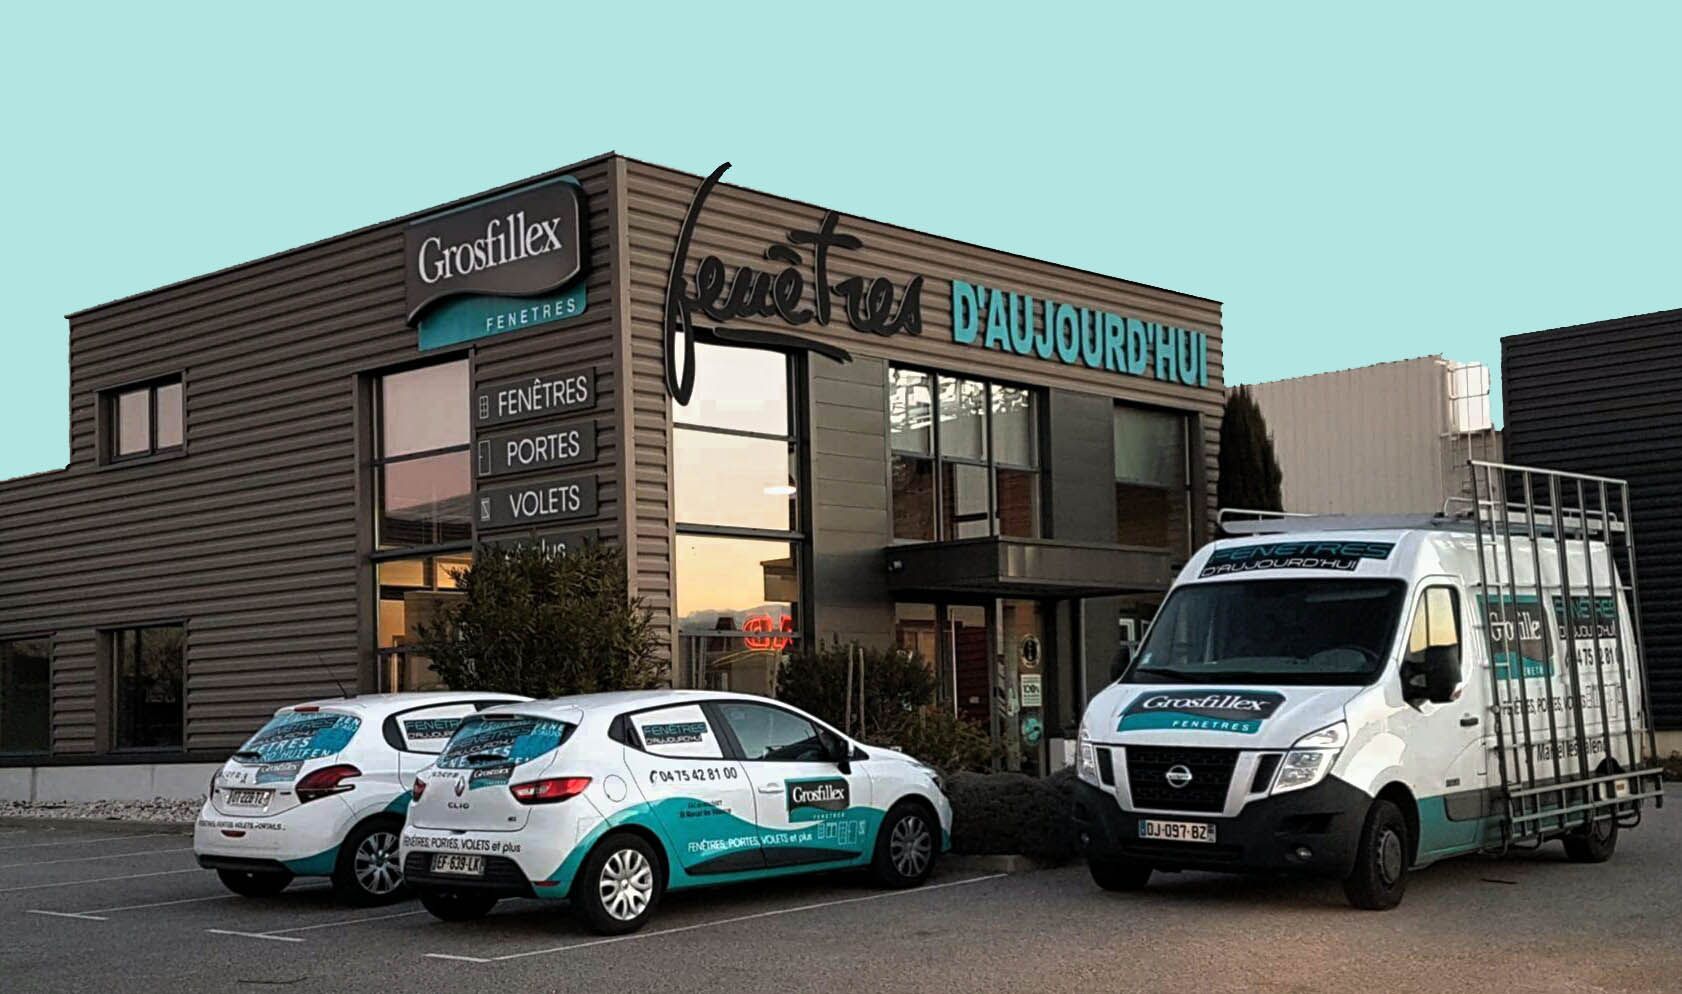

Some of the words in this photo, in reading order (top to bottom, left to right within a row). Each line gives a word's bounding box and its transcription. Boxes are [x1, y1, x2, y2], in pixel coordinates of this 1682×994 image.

[418, 210, 563, 285] Grosfillex
[486, 297, 577, 332] FENETRES
[951, 279, 1209, 388] D'AUJOURD'HUI
[498, 375, 589, 417] FENÊTRES
[507, 430, 580, 467] PORTES
[509, 484, 581, 518] VOLETS
[1201, 557, 1358, 577] D'AUJOURD'HUI
[1583, 648, 1594, 666] 75
[1143, 694, 1271, 711] Grosfillex
[1172, 719, 1250, 732] FENETRES
[659, 770, 674, 782] 04
[674, 769, 691, 782] 75
[692, 768, 706, 781] 42
[707, 767, 721, 781] 81
[723, 766, 738, 779] 00
[792, 784, 845, 803] Grosfillex
[447, 802, 470, 810] CLIO
[1146, 821, 1207, 841] DJ-097-BZ
[461, 838, 490, 852] VOLETS
[491, 840, 500, 852] et
[502, 841, 522, 854] plus
